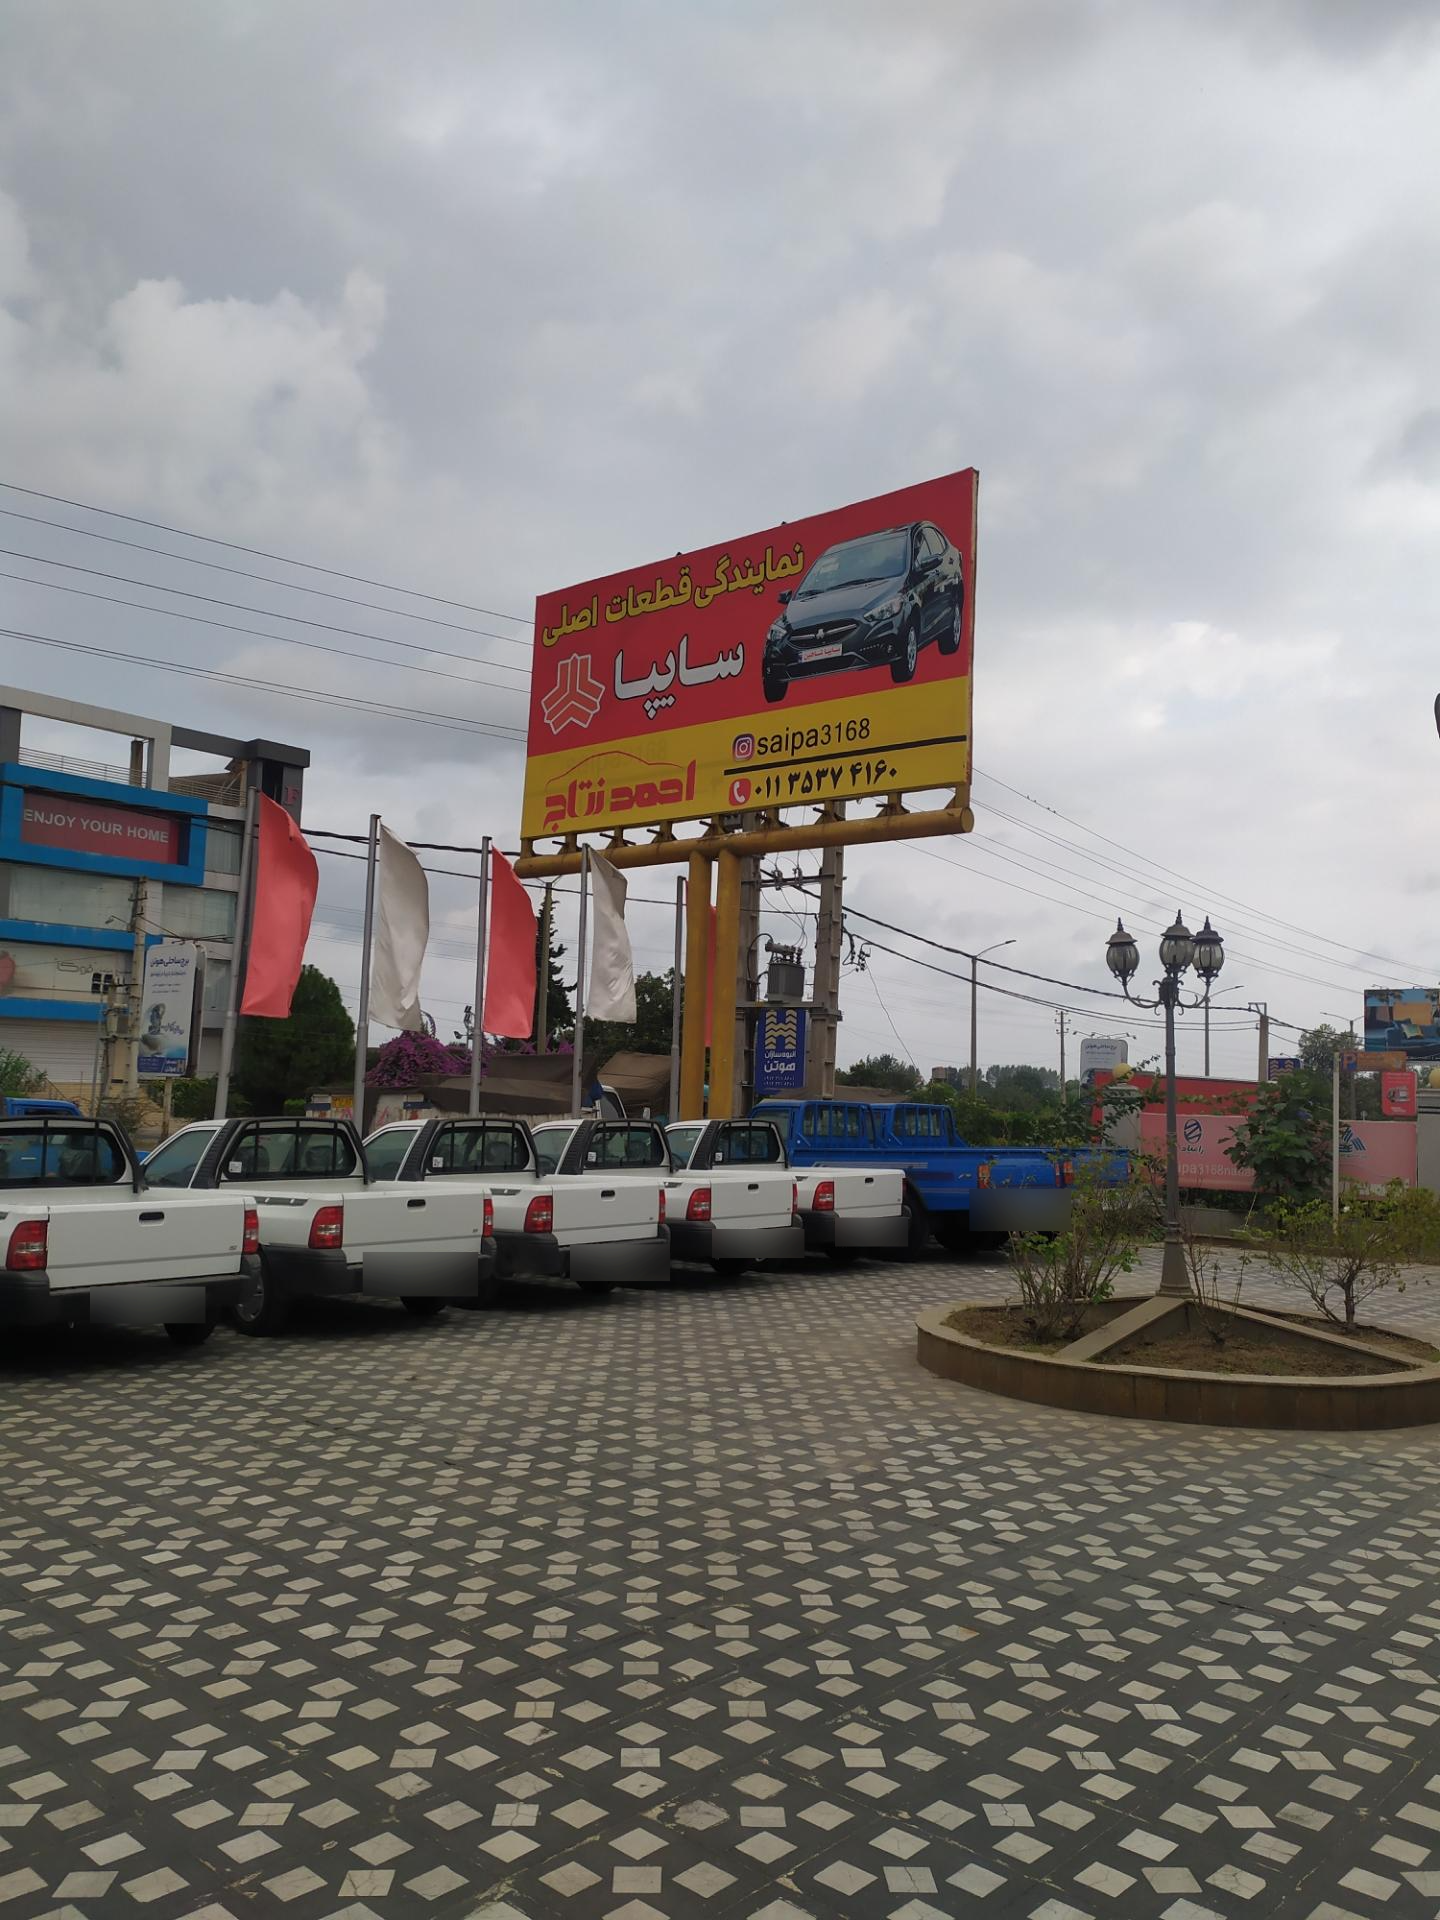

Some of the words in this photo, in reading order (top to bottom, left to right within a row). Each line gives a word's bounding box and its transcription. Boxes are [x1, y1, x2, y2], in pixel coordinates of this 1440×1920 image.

[605, 566, 693, 623] قطعات
[694, 543, 805, 608] نمایندگی
[541, 596, 598, 647] اصلی
[613, 633, 745, 720] سایپا
[757, 718, 870, 756] saipa3168
[543, 777, 607, 833] نتاج
[609, 759, 697, 812] احمد
[755, 775, 781, 799] ۰۱۱
[787, 764, 844, 796] ۳۵۳۷
[849, 759, 898, 787] ۴۱۶۰
[23, 809, 76, 829] ENJOY
[80, 818, 122, 836] YOUR
[127, 826, 169, 843] HOME
[764, 1060, 796, 1073] هوتن
